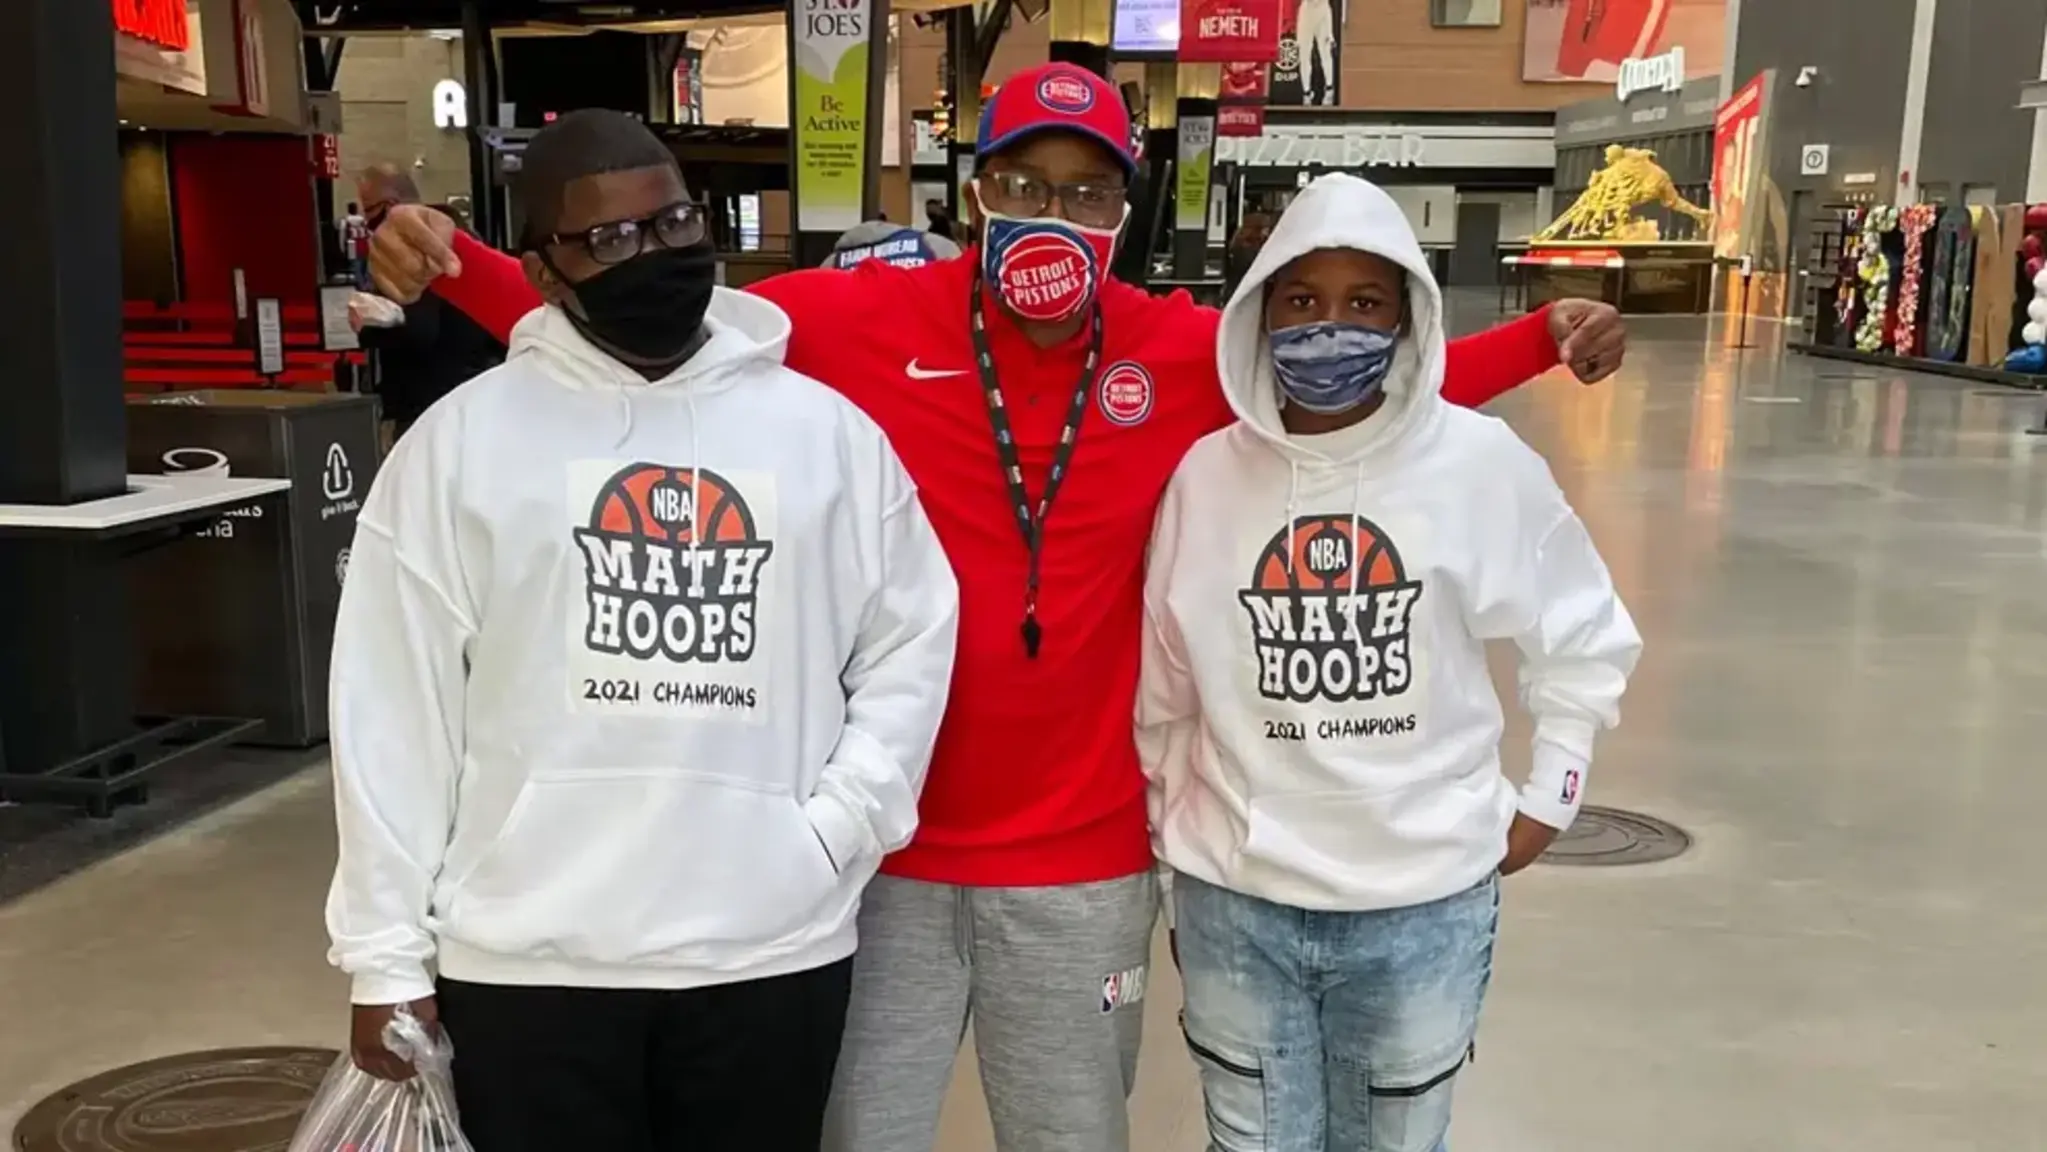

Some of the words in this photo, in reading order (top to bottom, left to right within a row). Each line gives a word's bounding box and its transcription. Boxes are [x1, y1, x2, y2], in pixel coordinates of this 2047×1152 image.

[806, 13, 862, 39] JOES
[1199, 16, 1259, 38] NEMETH
[433, 78, 467, 128] A
[821, 94, 844, 113] Be
[804, 115, 861, 132] Active
[1213, 135, 1327, 167] PIZZA
[1340, 134, 1426, 167] BAR
[1011, 256, 1075, 287] DETROIT
[1014, 273, 1080, 305] PISTONS
[653, 487, 692, 522] NBA
[580, 533, 768, 599] MATH
[1310, 537, 1348, 571] NBA
[591, 591, 753, 655] HOOPS
[1243, 586, 1418, 642] MATH
[1258, 637, 1408, 696] HOOPS
[583, 678, 640, 703] 2021
[653, 681, 757, 709] CHAMPIONS
[1264, 720, 1306, 741] 2021
[1317, 713, 1416, 739] CHAMPIONS
